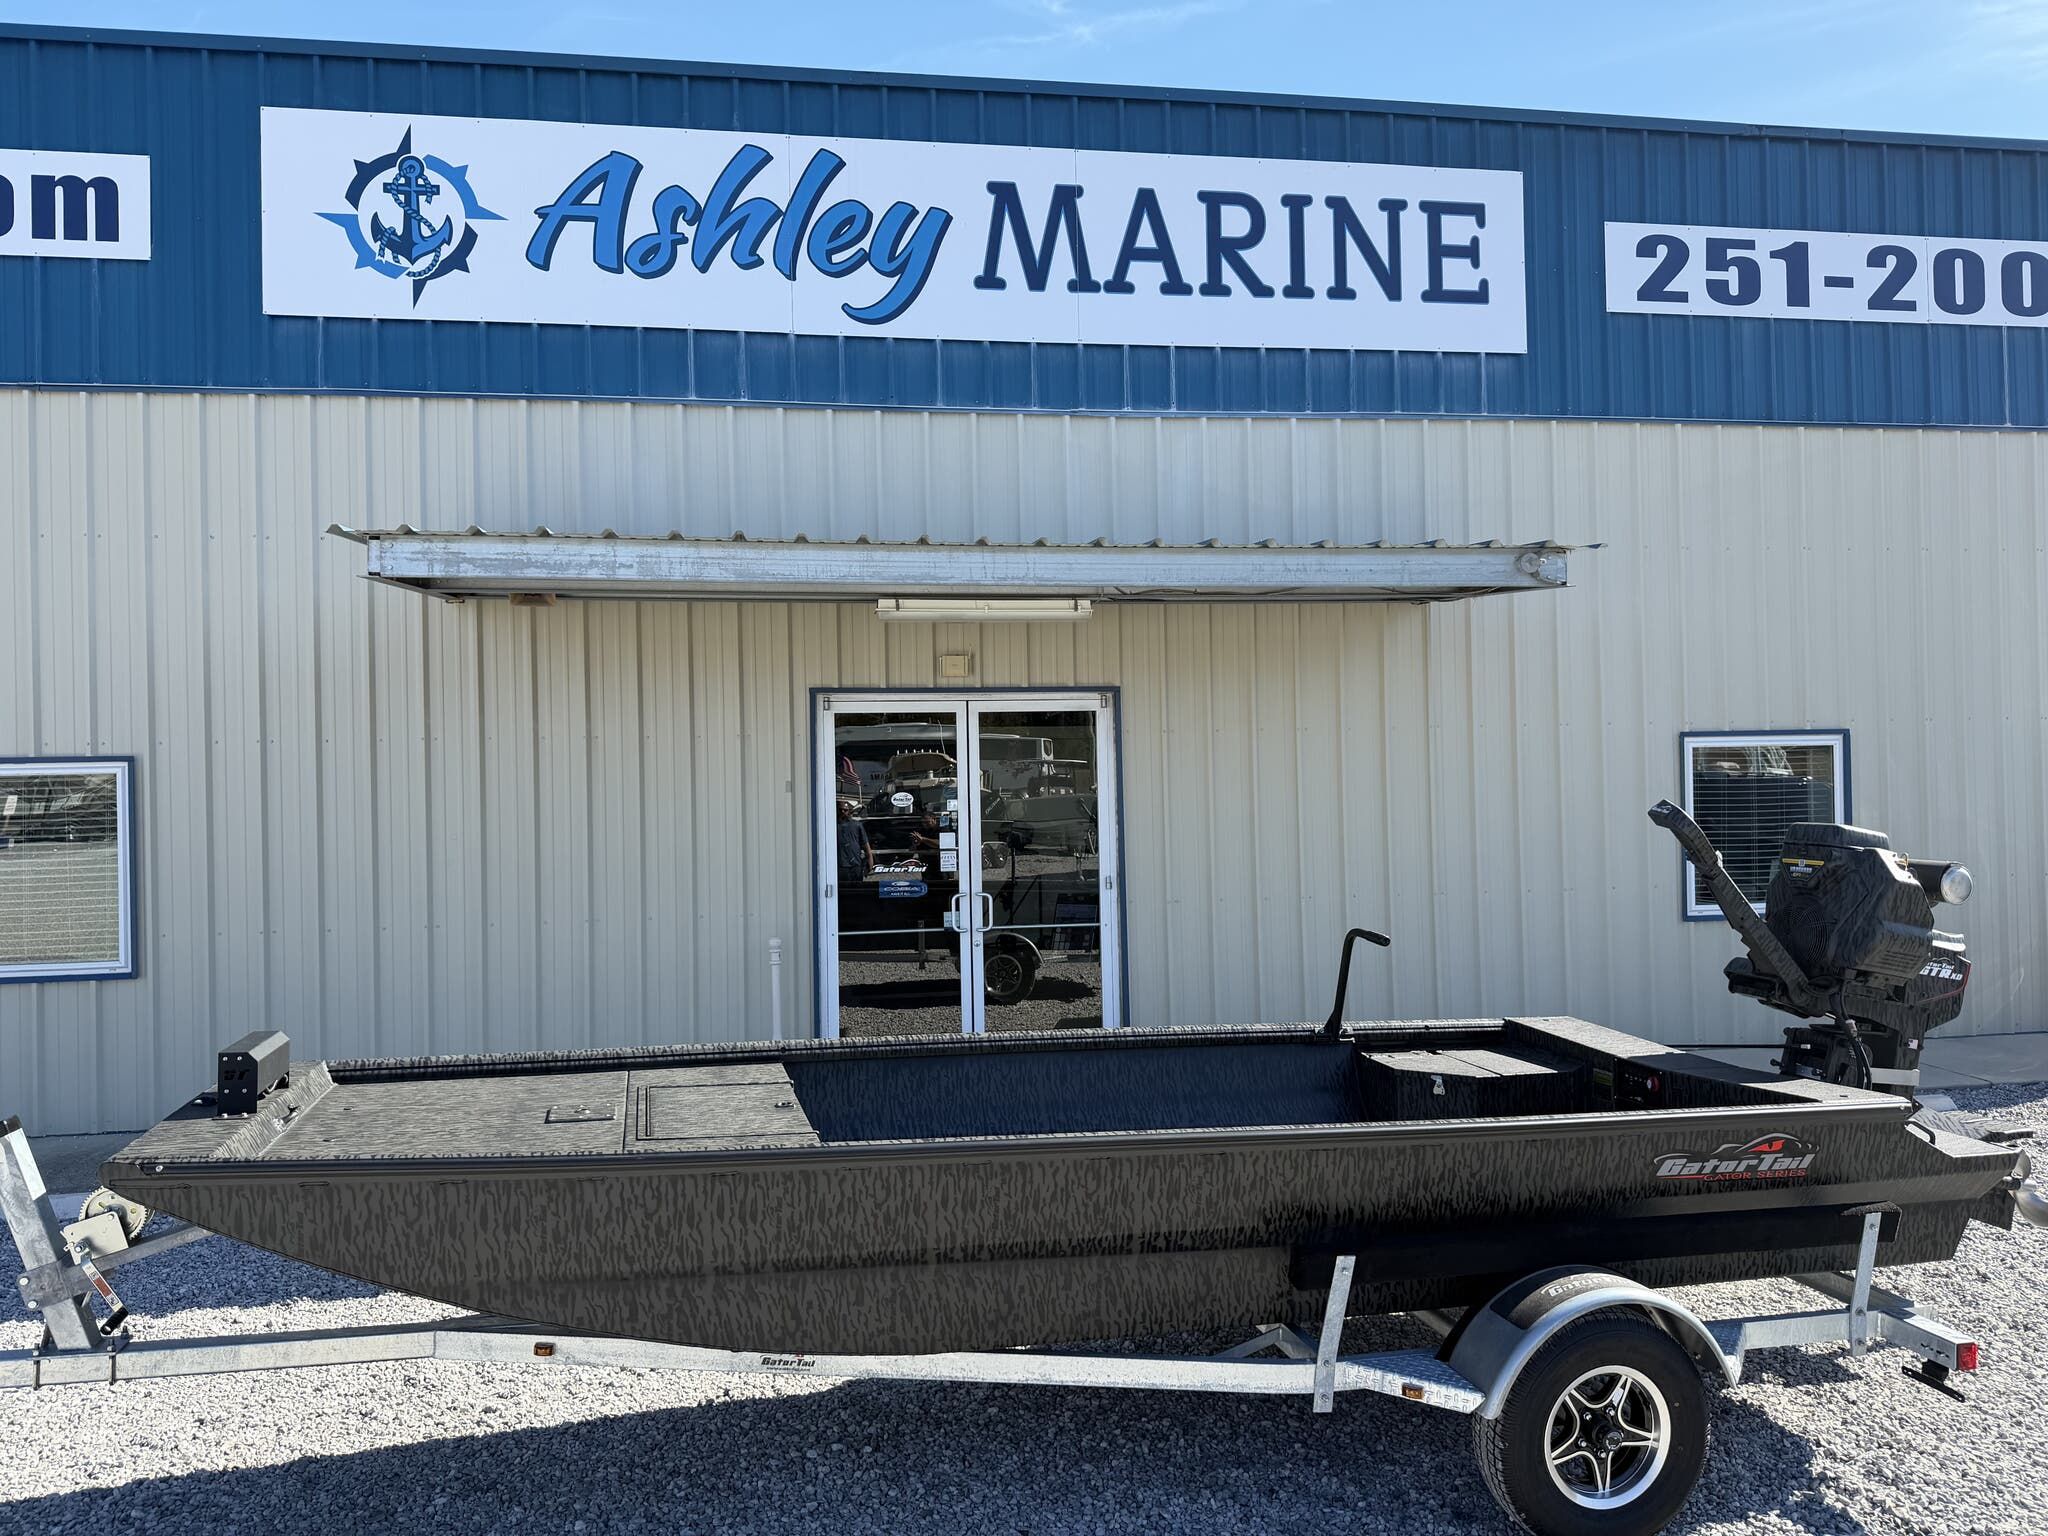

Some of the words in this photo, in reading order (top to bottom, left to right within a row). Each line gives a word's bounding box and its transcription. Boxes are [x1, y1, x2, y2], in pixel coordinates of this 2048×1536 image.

[0, 174, 119, 242] m
[525, 143, 952, 324] Ashley
[974, 180, 1489, 305] MARINE
[1635, 233, 2048, 318] 251-200
[1656, 1153, 1816, 1177] GatorTail
[1703, 1171, 1752, 1182] GATOR
[1756, 1168, 1808, 1179] SERIES
[761, 1357, 816, 1367] GatorTail
